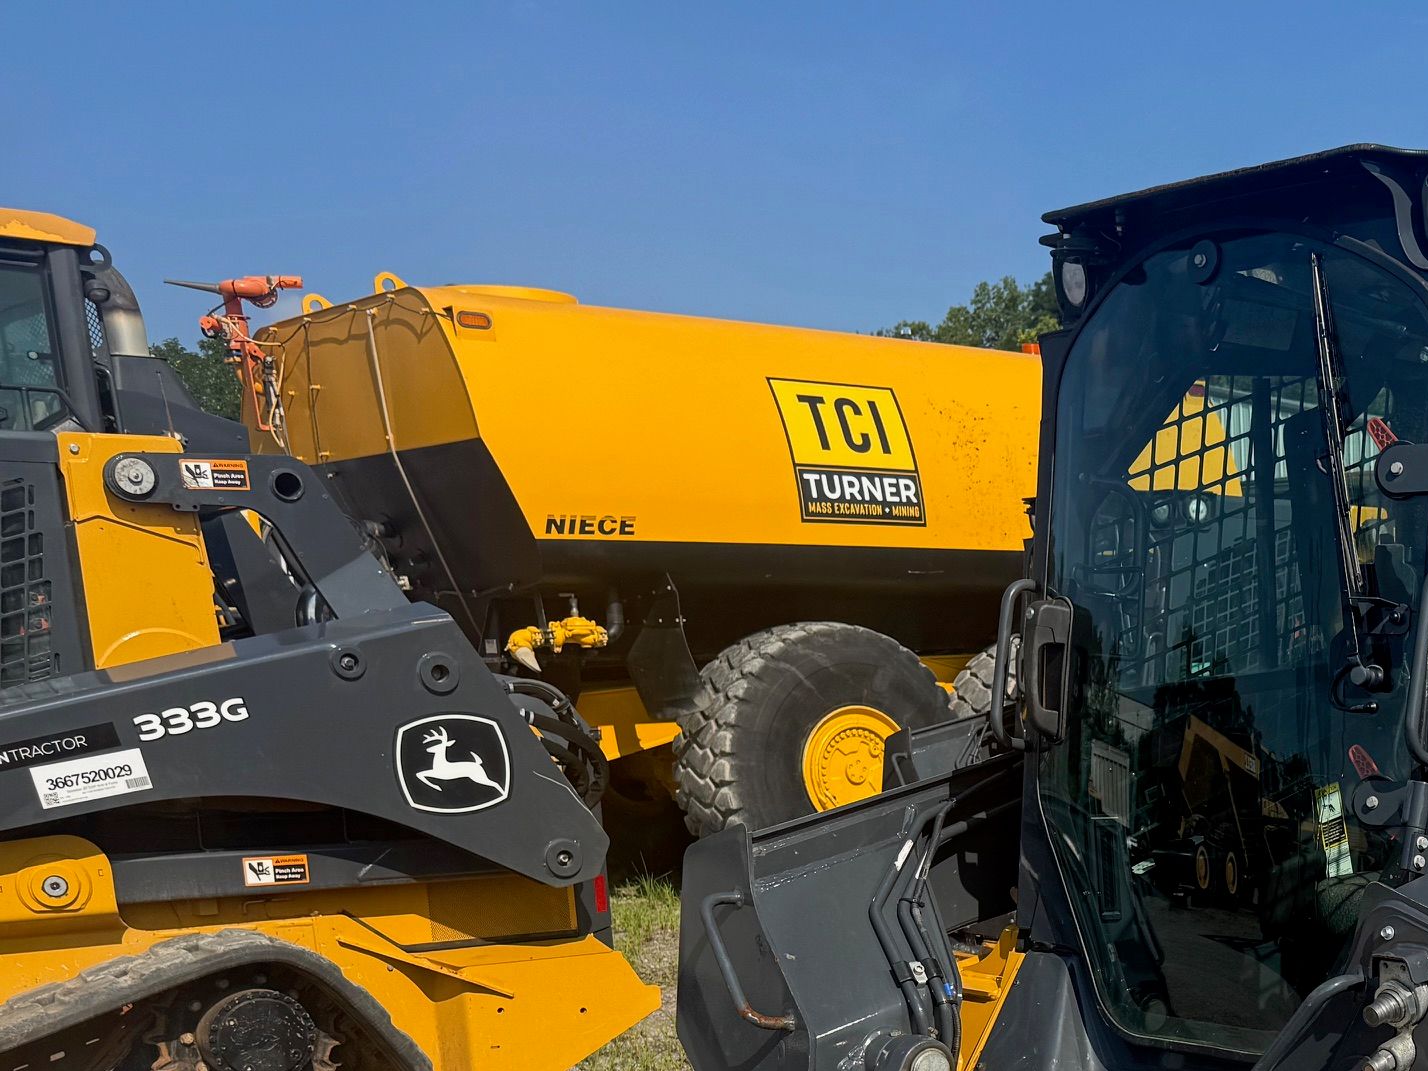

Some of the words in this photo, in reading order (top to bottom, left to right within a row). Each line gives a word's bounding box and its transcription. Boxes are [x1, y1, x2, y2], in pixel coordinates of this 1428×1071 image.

[796, 394, 892, 455] TCI
[803, 473, 918, 504] TURNER
[545, 514, 636, 535] NIECE
[808, 502, 832, 514] MASS
[834, 502, 882, 516] EXCAVATION
[892, 505, 919, 518] MINING
[132, 697, 250, 742] 333G
[46, 764, 132, 791] 3667520029
